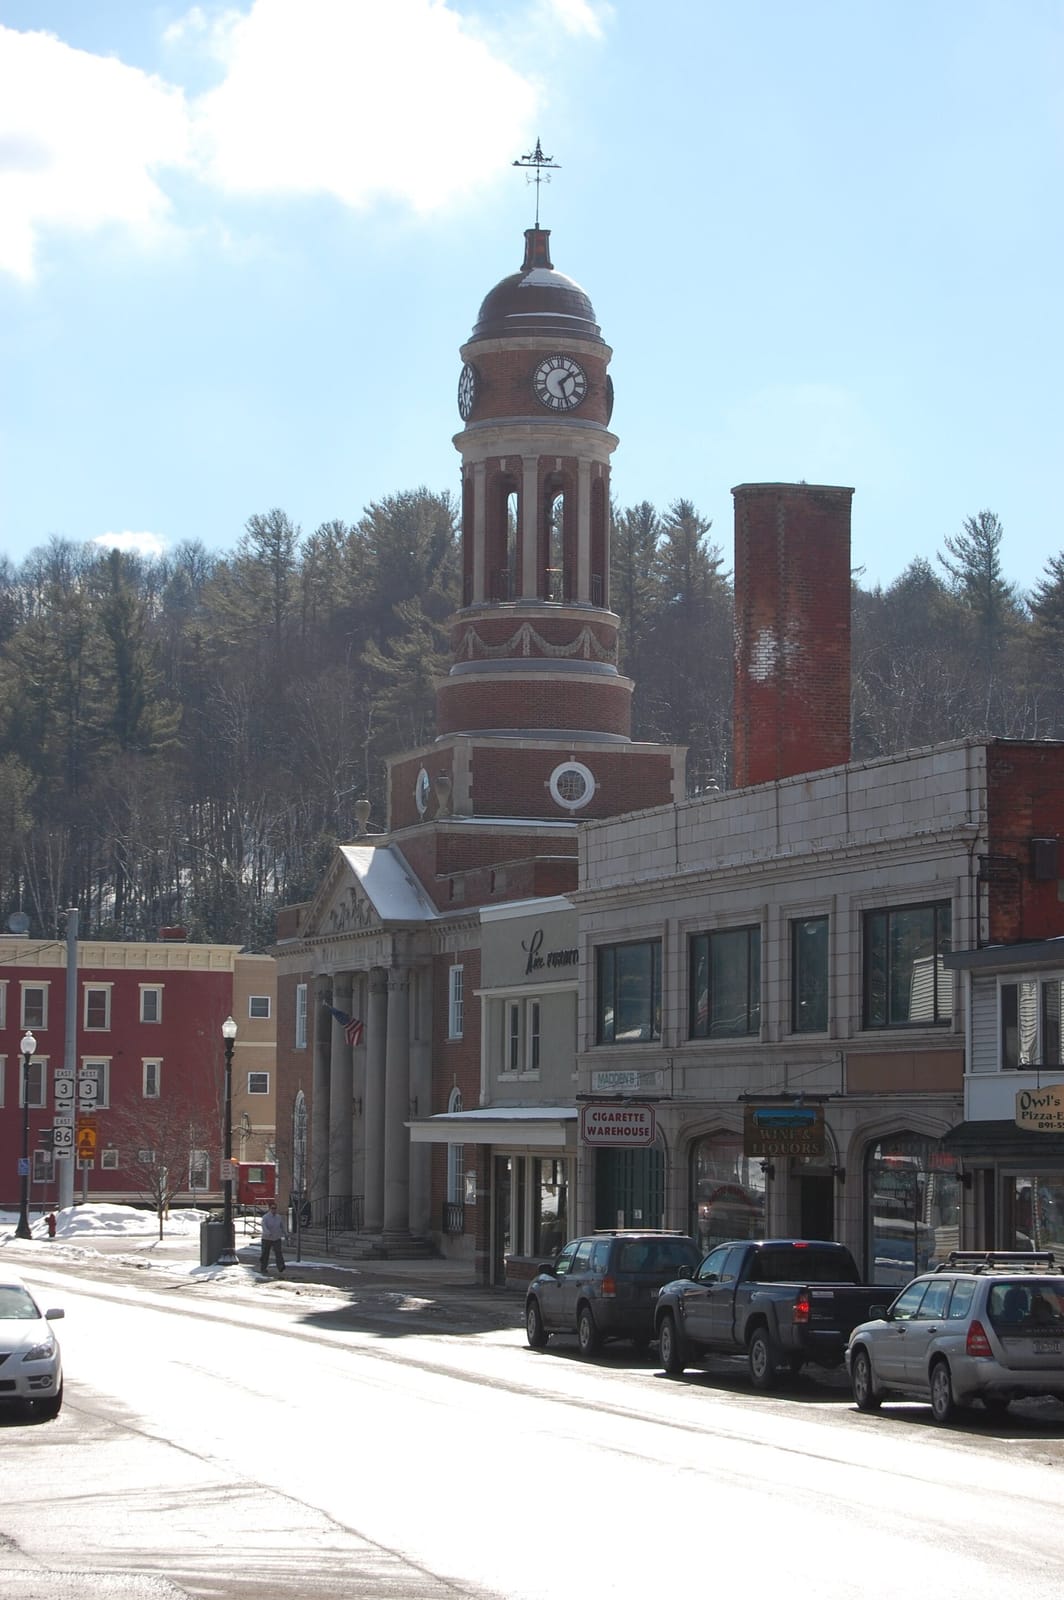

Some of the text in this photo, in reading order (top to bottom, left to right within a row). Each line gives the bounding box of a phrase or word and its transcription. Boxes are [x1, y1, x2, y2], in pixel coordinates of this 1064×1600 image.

[60, 1083, 68, 1094] 3
[85, 1084, 92, 1095] 3
[1020, 1091, 1061, 1110] Owl's
[592, 1112, 645, 1122] CIGARETTE
[55, 1131, 71, 1143] 86
[587, 1126, 650, 1137] WAREHOUSE
[760, 1129, 796, 1139] WINE
[752, 1143, 818, 1154] LIQUORS
